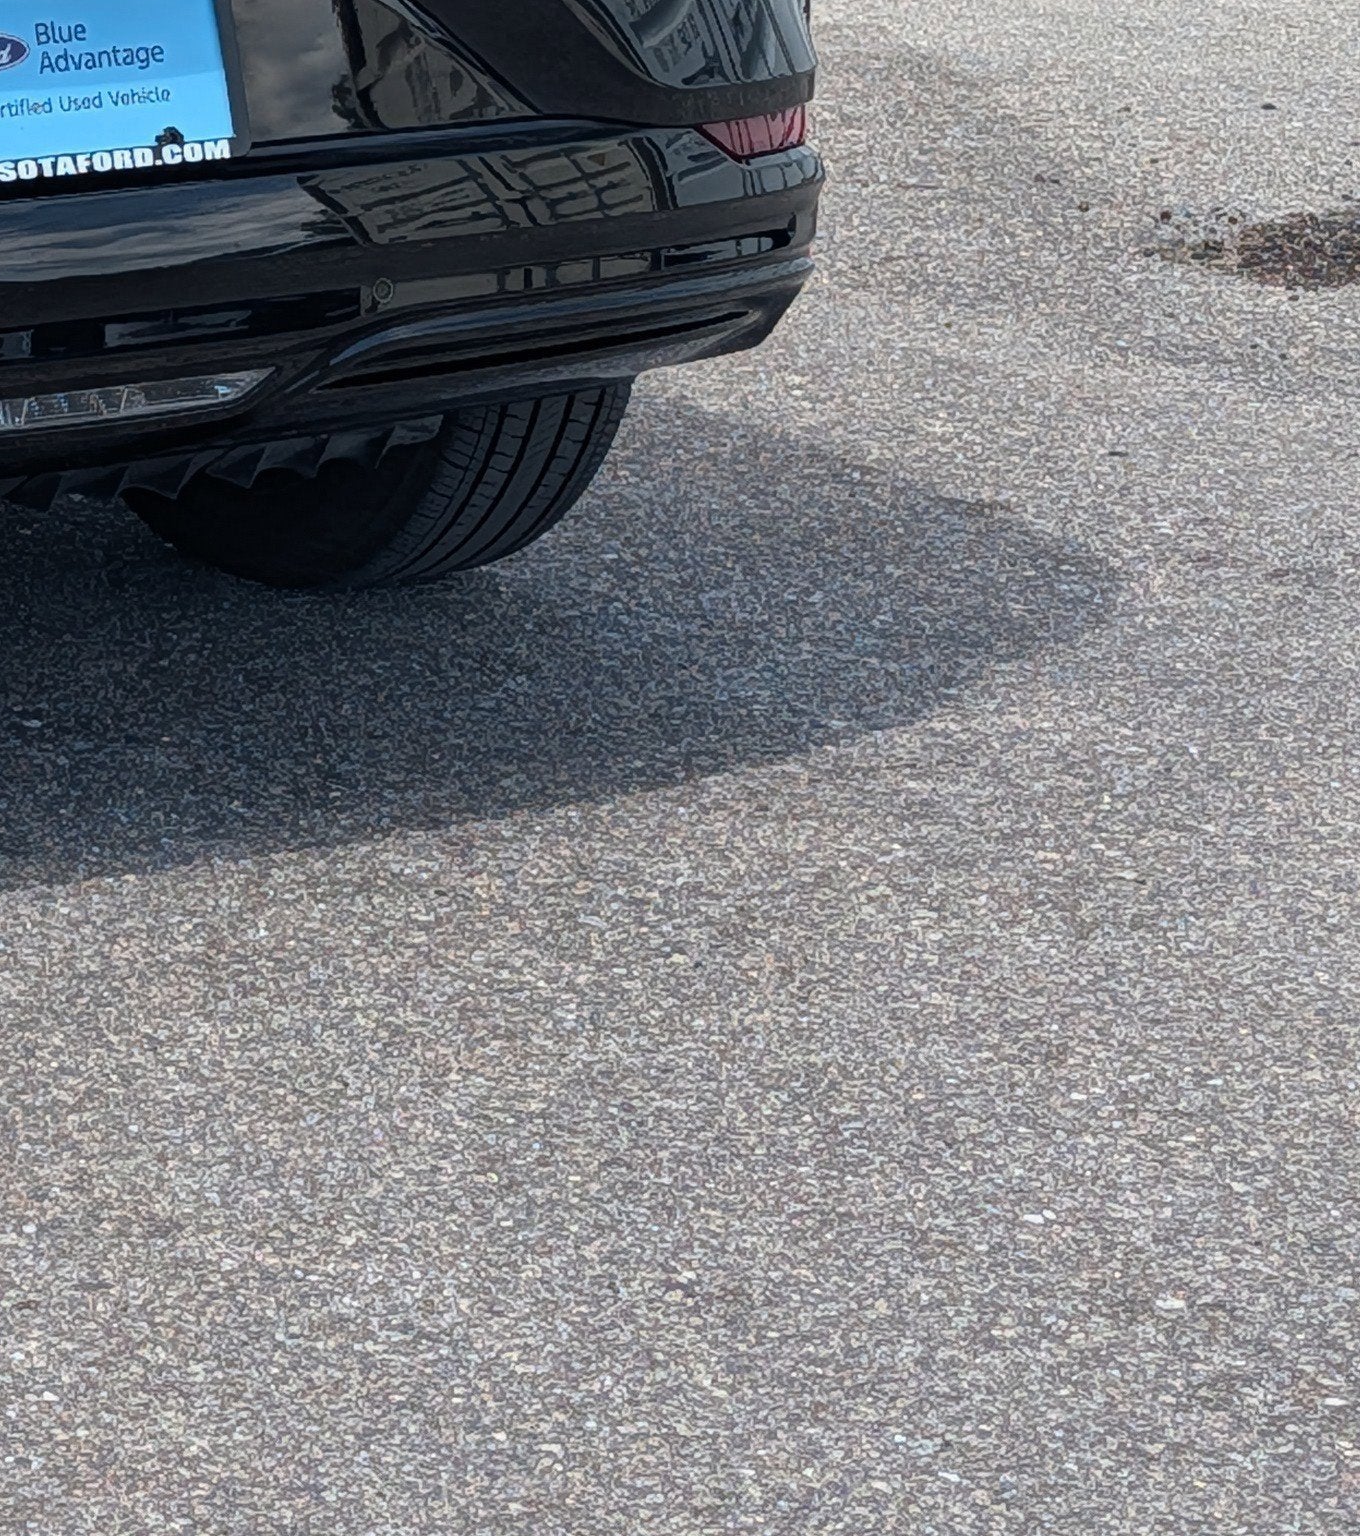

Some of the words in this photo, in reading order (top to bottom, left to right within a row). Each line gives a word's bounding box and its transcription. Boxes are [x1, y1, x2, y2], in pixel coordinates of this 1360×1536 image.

[34, 21, 87, 46] Blue
[39, 41, 165, 75] Advantage
[59, 91, 103, 112] Used
[107, 86, 171, 107] Vehicle
